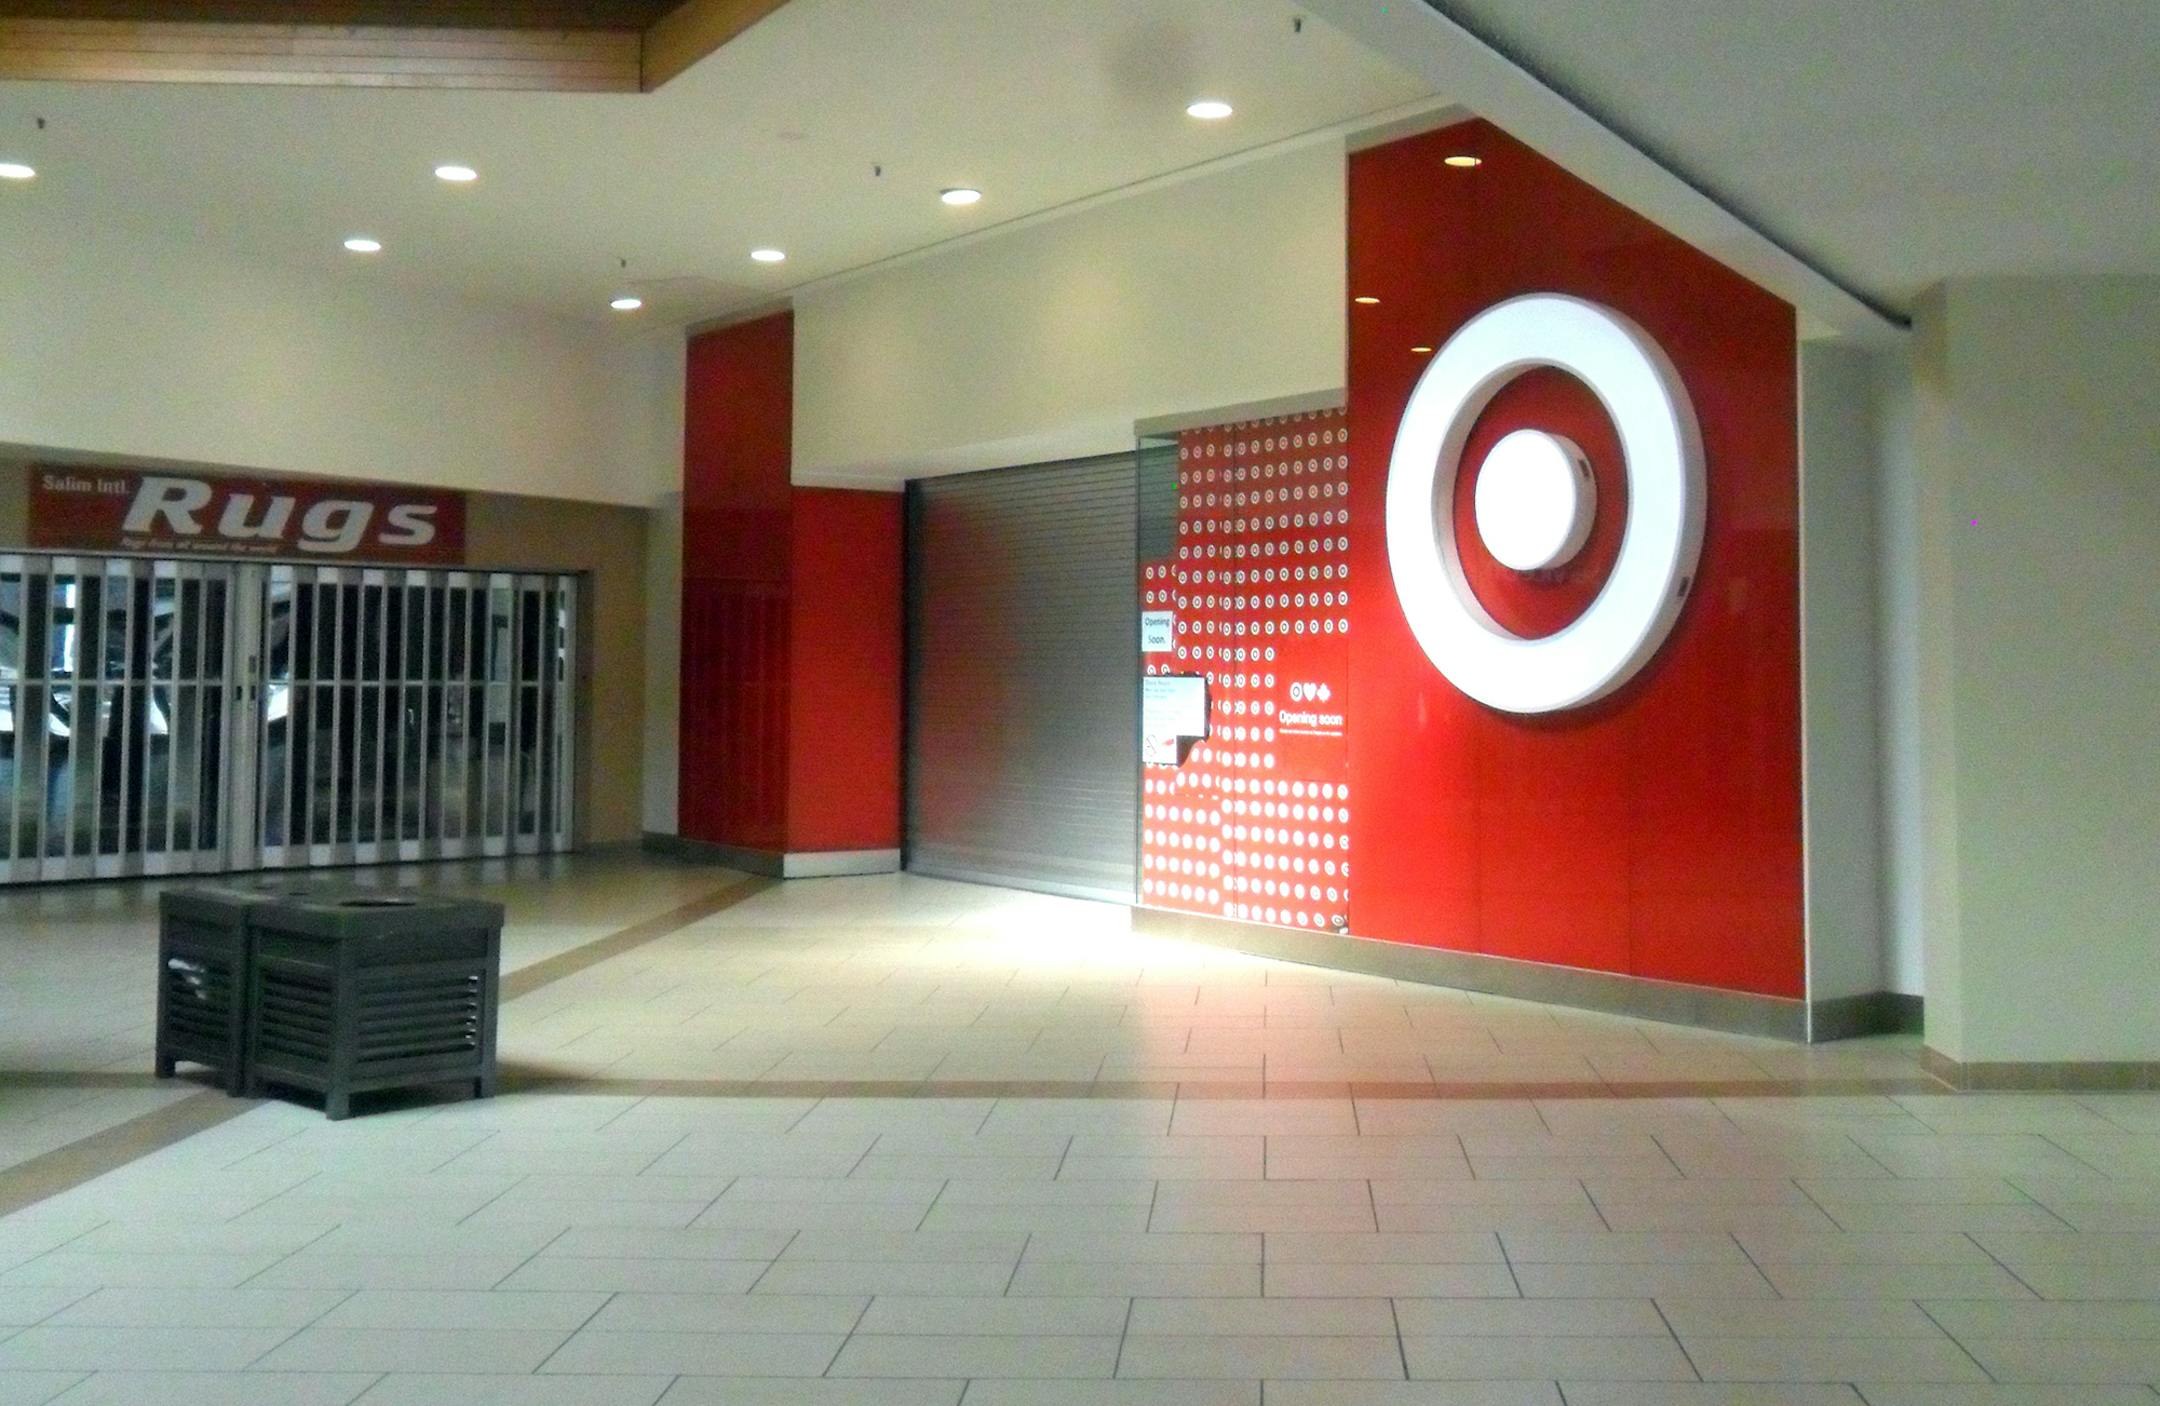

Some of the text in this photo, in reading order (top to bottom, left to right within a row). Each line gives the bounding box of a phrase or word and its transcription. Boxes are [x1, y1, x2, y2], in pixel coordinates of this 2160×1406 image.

[42, 474, 92, 493] Salim
[122, 476, 438, 553] Rugs
[1145, 616, 1170, 628] Opening
[1279, 709, 1344, 728] Opening soon
